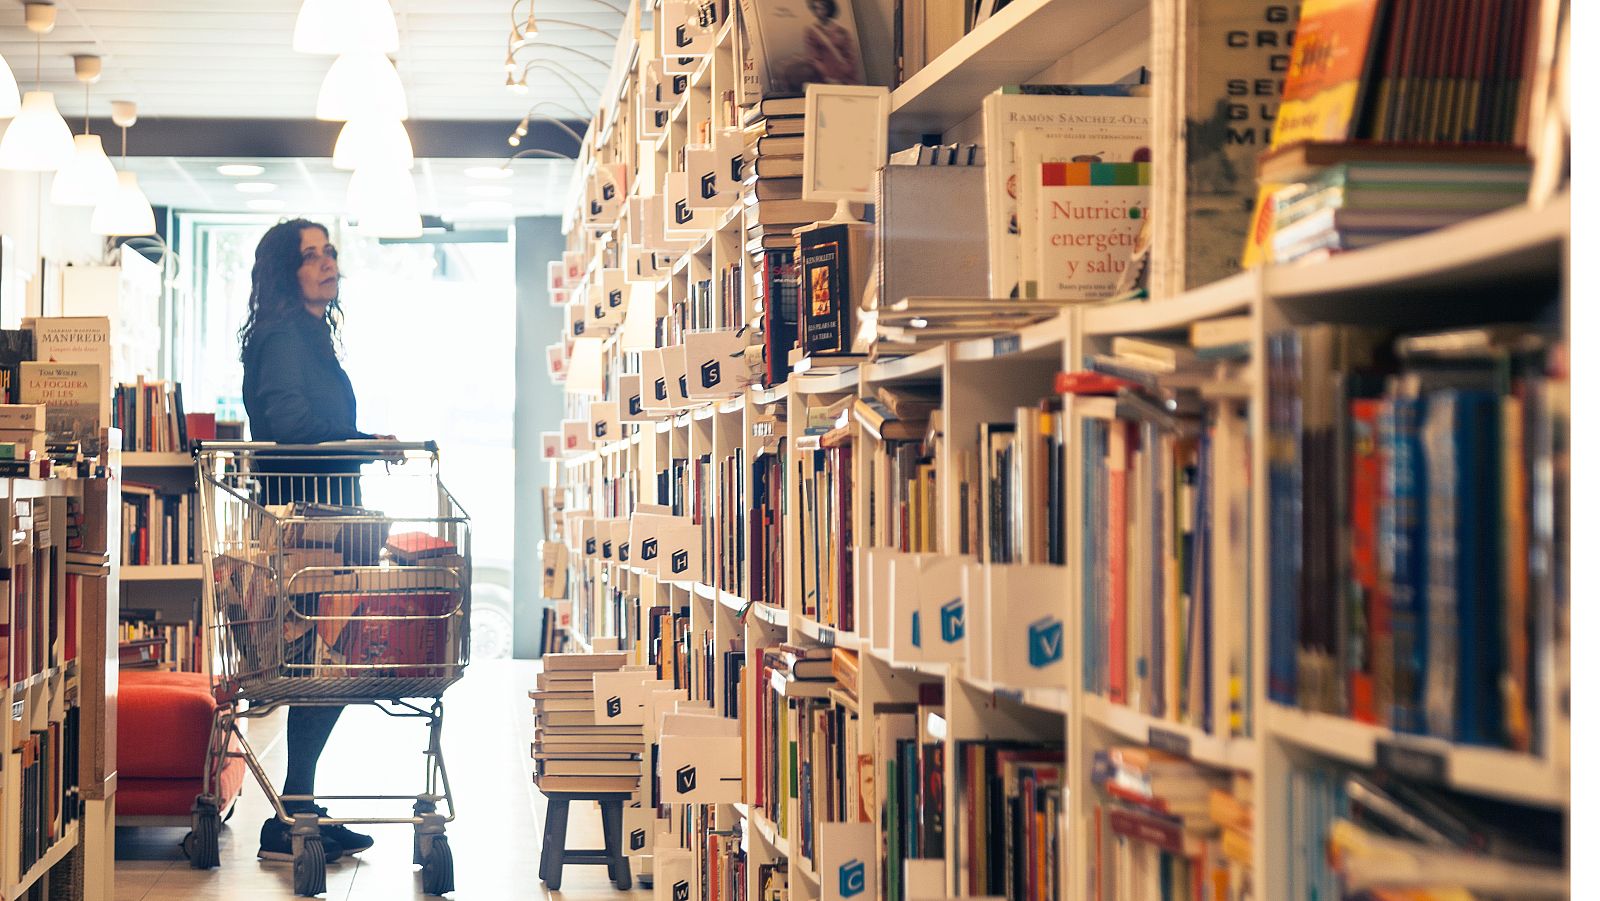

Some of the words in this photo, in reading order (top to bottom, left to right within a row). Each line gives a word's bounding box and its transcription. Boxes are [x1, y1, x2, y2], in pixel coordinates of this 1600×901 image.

[1067, 260, 1080, 279] y
[42, 333, 106, 342] MANFREDI
[30, 380, 41, 388] LA
[44, 380, 88, 388] FOGUERA
[1040, 629, 1062, 658] V
